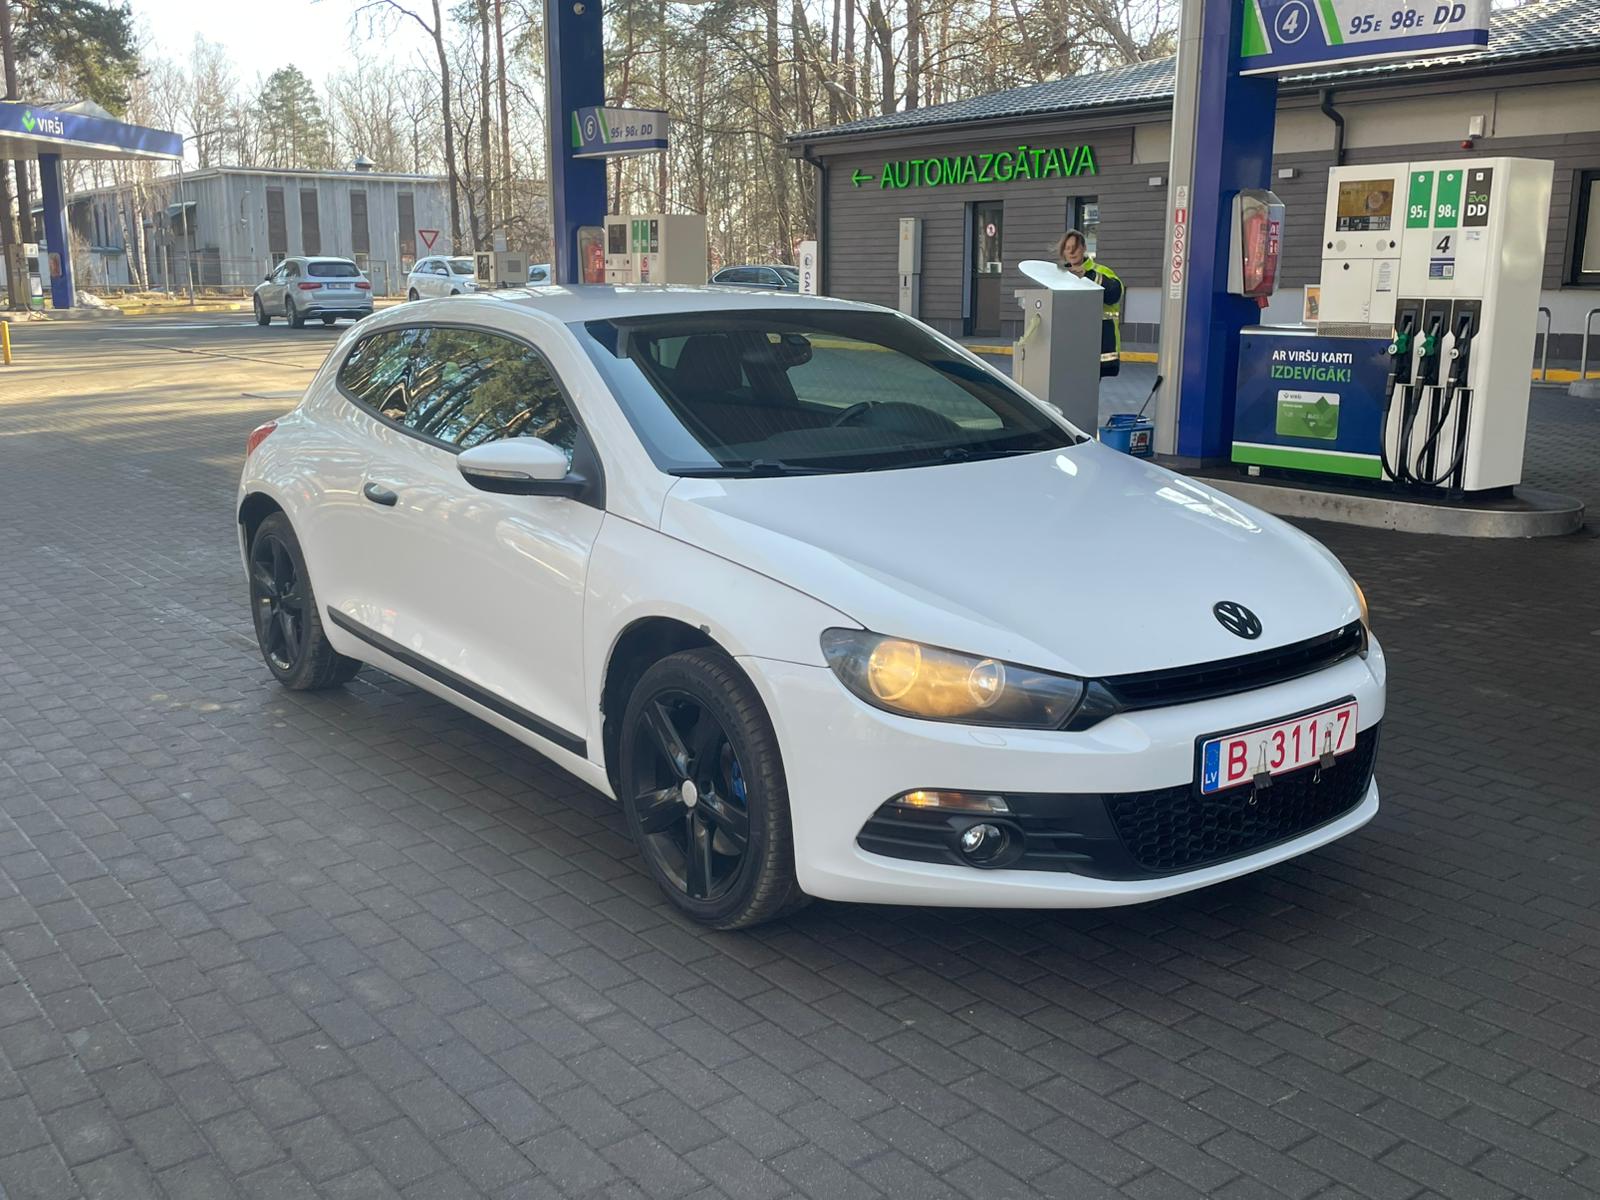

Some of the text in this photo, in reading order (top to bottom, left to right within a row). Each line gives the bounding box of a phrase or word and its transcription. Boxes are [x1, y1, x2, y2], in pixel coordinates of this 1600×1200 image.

[1282, 9, 1299, 34] 4
[1433, 3, 1466, 25] DD
[37, 116, 64, 135] VIRŠI
[587, 121, 594, 136] 6
[641, 123, 653, 135] DD
[880, 145, 1097, 189] AUTOMAZGĀTAVA
[1467, 204, 1487, 217] DD
[1436, 235, 1451, 253] 4
[1272, 349, 1353, 364] AR VIRŠU KARTI
[1271, 365, 1352, 383] IZDEVĪGĀK!
[1228, 740, 1248, 781] B
[1205, 771, 1217, 784] LV
